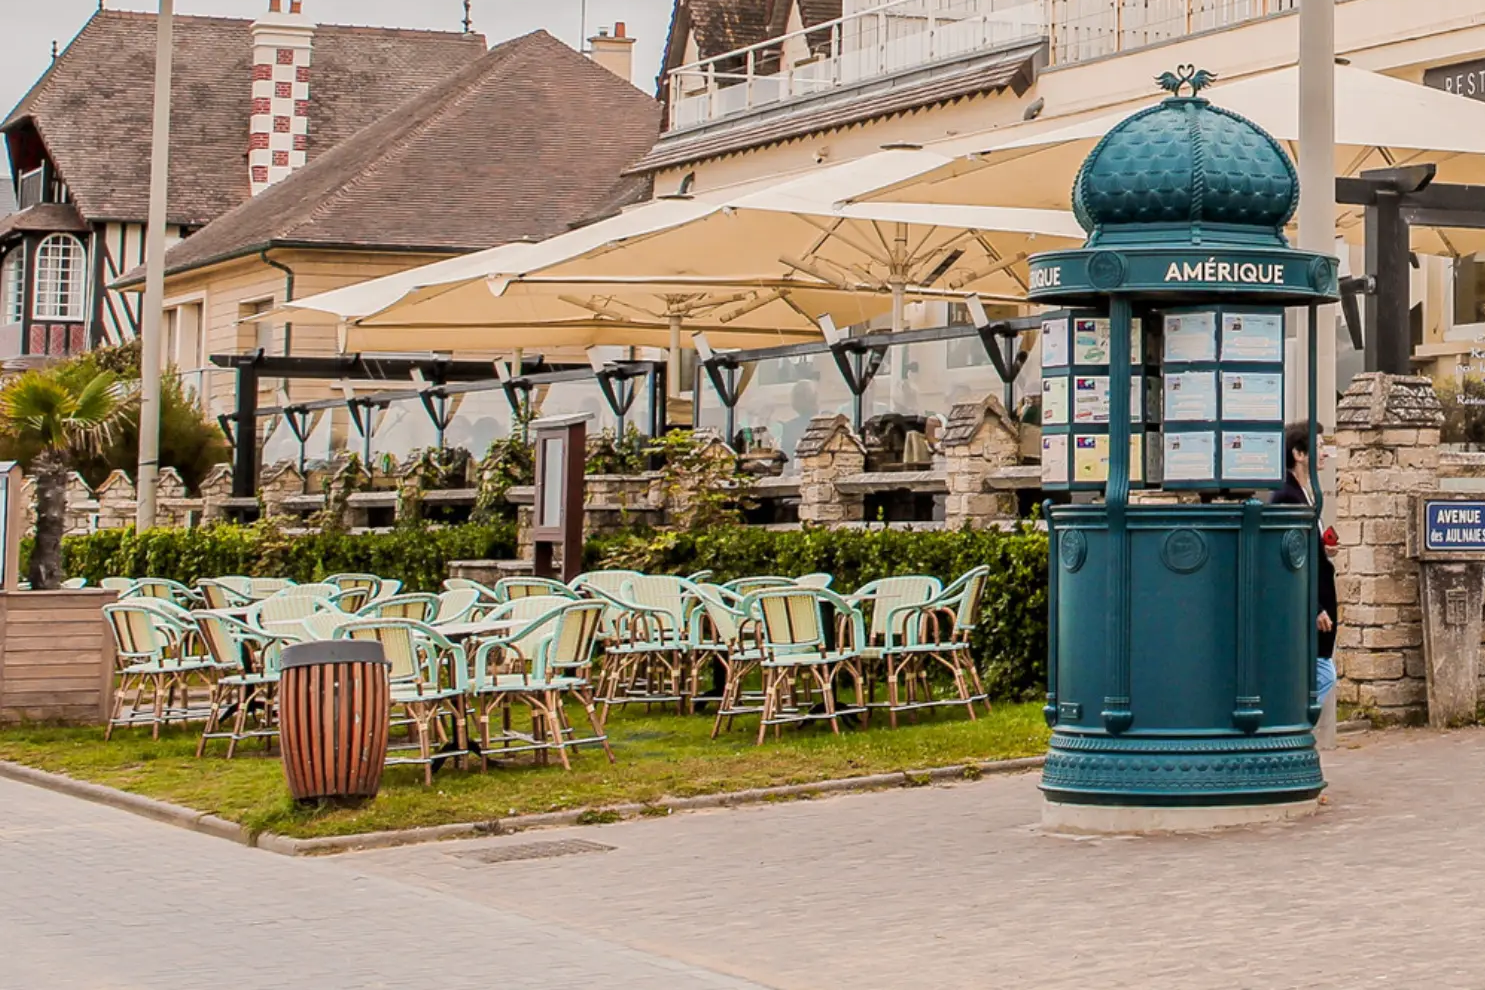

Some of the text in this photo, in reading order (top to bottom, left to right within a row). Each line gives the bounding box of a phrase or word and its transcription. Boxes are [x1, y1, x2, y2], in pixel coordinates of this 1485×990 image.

[1164, 257, 1284, 284] AMÉRIQUE
[1437, 509, 1481, 523] AVENUE
[1430, 528, 1444, 542] des
